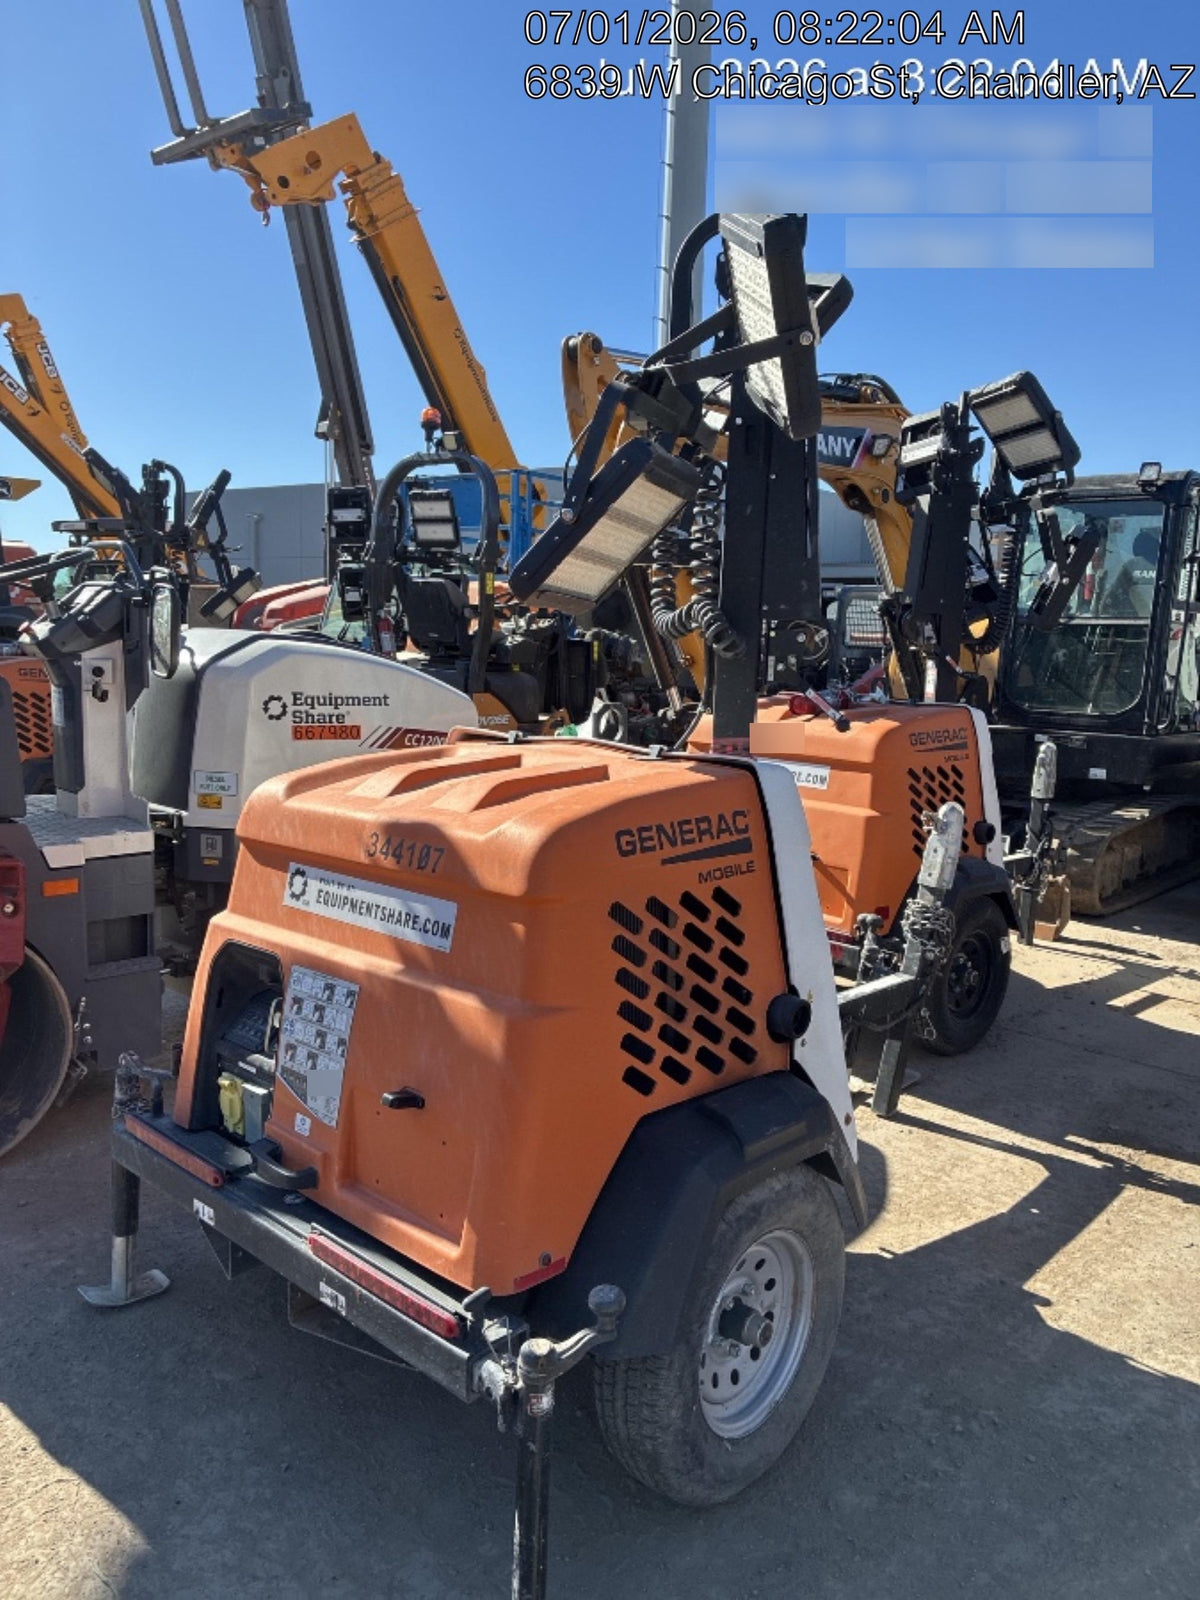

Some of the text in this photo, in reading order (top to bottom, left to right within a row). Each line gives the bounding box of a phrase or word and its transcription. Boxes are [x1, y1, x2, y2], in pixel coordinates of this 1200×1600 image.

[36, 341, 58, 379] JCB
[291, 692, 390, 708] Equipment
[291, 709, 346, 725] Share
[909, 727, 968, 747] GENERAC
[615, 810, 750, 858] GENERAC
[366, 832, 446, 874] 344107
[698, 860, 756, 884] MOBILE
[316, 889, 452, 941] EQUIPMENTSHARE.COM
